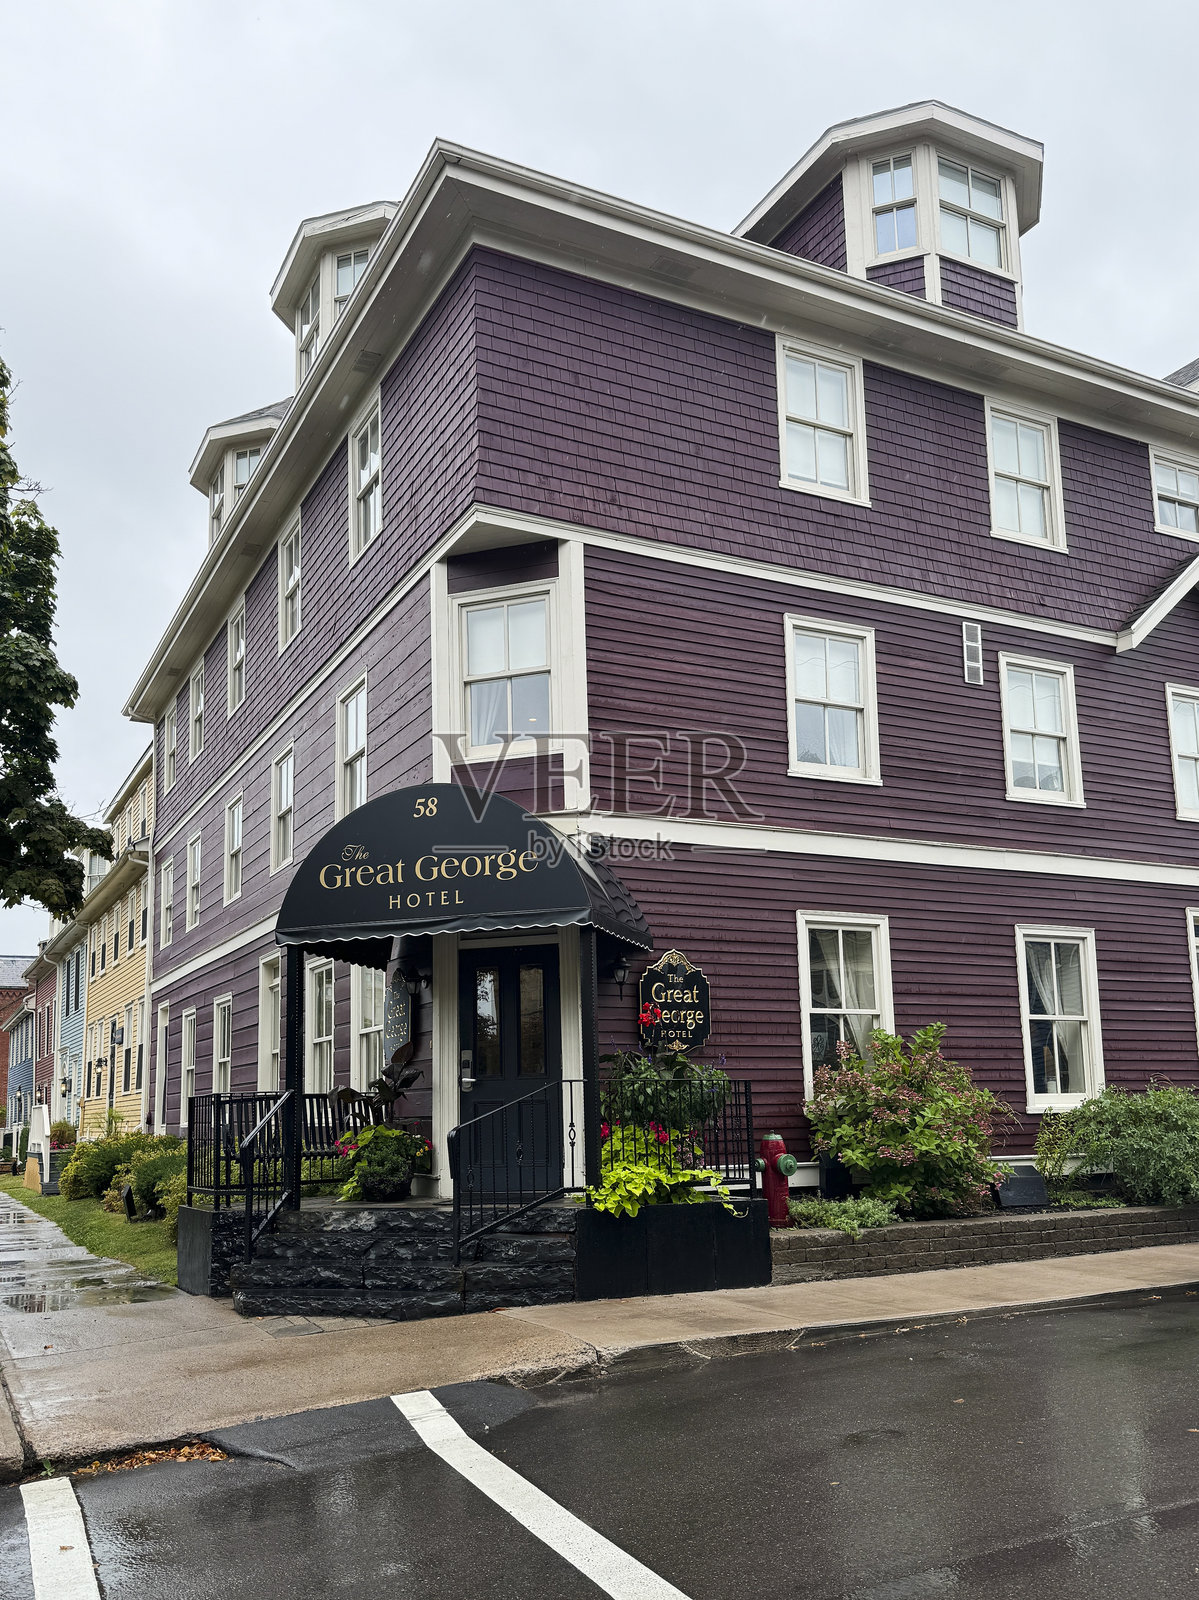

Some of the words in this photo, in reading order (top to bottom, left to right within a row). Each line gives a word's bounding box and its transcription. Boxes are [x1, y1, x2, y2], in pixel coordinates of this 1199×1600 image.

[412, 797, 438, 818] 58
[341, 844, 370, 862] The
[319, 858, 404, 890] Great
[414, 848, 539, 881] George
[389, 890, 464, 910] HOTEL
[667, 973, 684, 983] The
[651, 982, 699, 1003] Great
[650, 1003, 704, 1030] eorge
